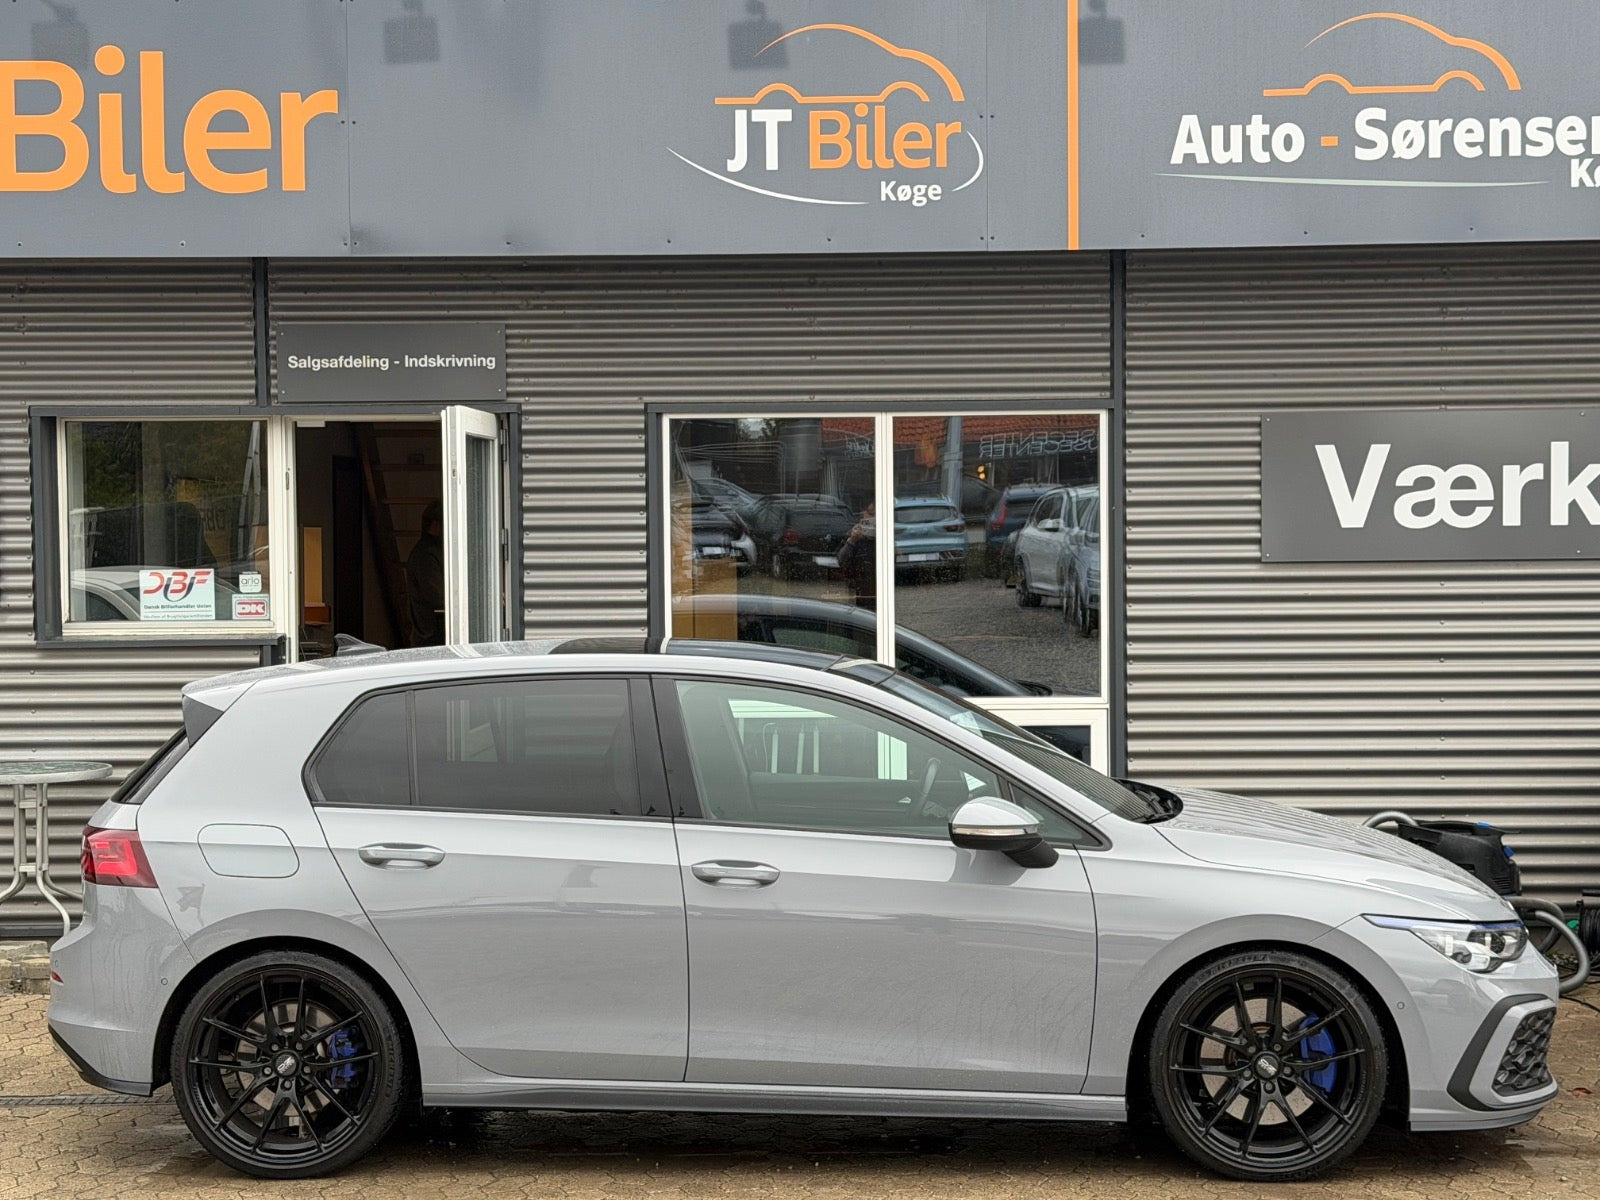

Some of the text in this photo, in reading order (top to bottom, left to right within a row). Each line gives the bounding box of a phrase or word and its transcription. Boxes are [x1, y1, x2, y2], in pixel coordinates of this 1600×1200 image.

[0, 45, 339, 194] Biler
[727, 103, 962, 172] JT Biler
[1170, 114, 1305, 165] Auto
[1354, 107, 1600, 161] Sørense
[880, 180, 942, 207] Køge
[1570, 158, 1600, 188] K
[287, 355, 390, 372] Salgsafdeling
[404, 354, 496, 370] Indskrivning
[1314, 441, 1600, 529] Værk
